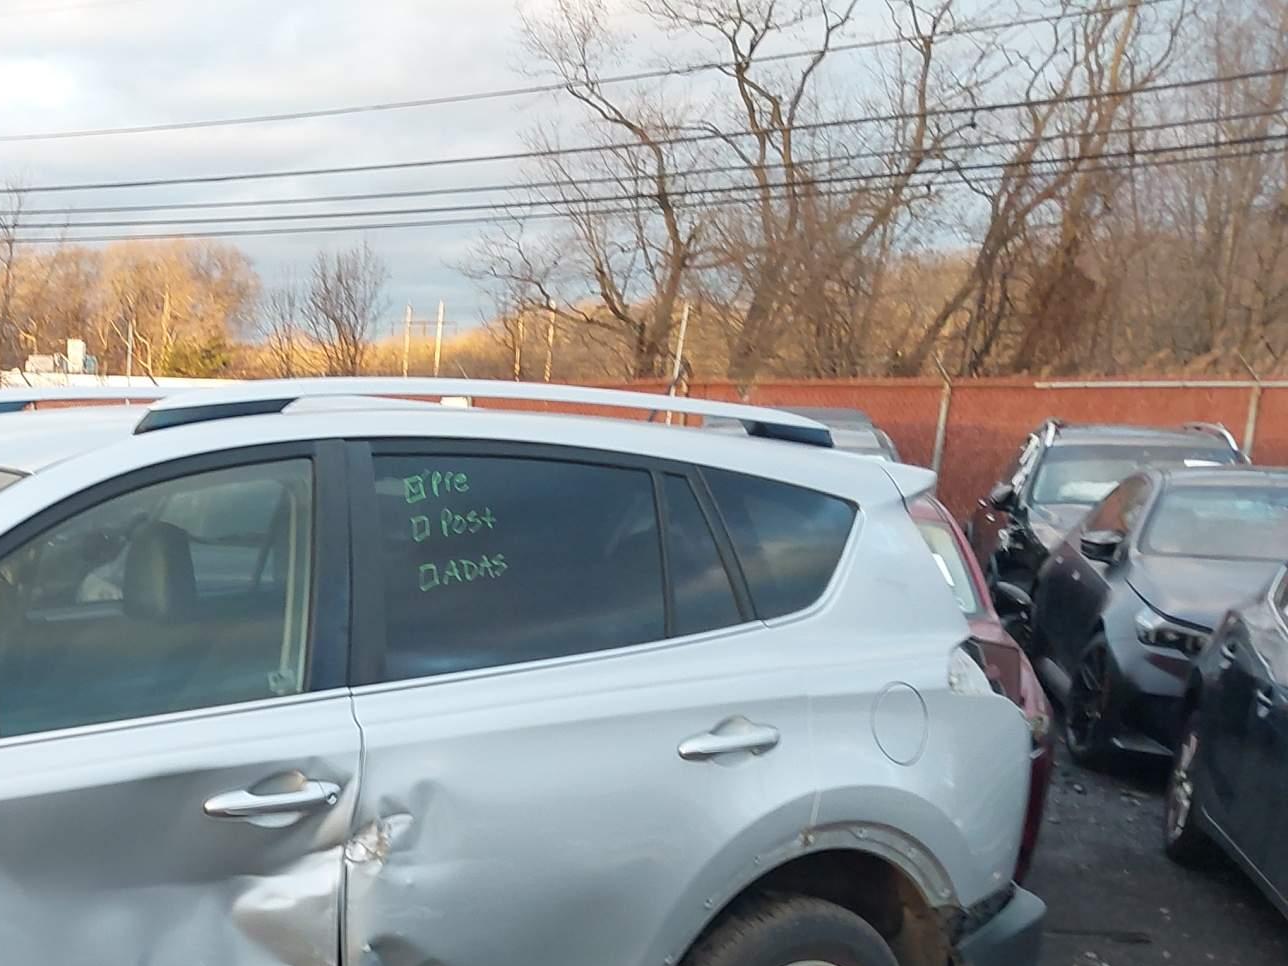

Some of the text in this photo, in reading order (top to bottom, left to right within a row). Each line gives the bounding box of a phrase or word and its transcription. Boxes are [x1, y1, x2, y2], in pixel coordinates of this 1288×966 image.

[430, 470, 470, 497] Pre
[440, 506, 496, 537] Post
[443, 553, 509, 585] ADAS
